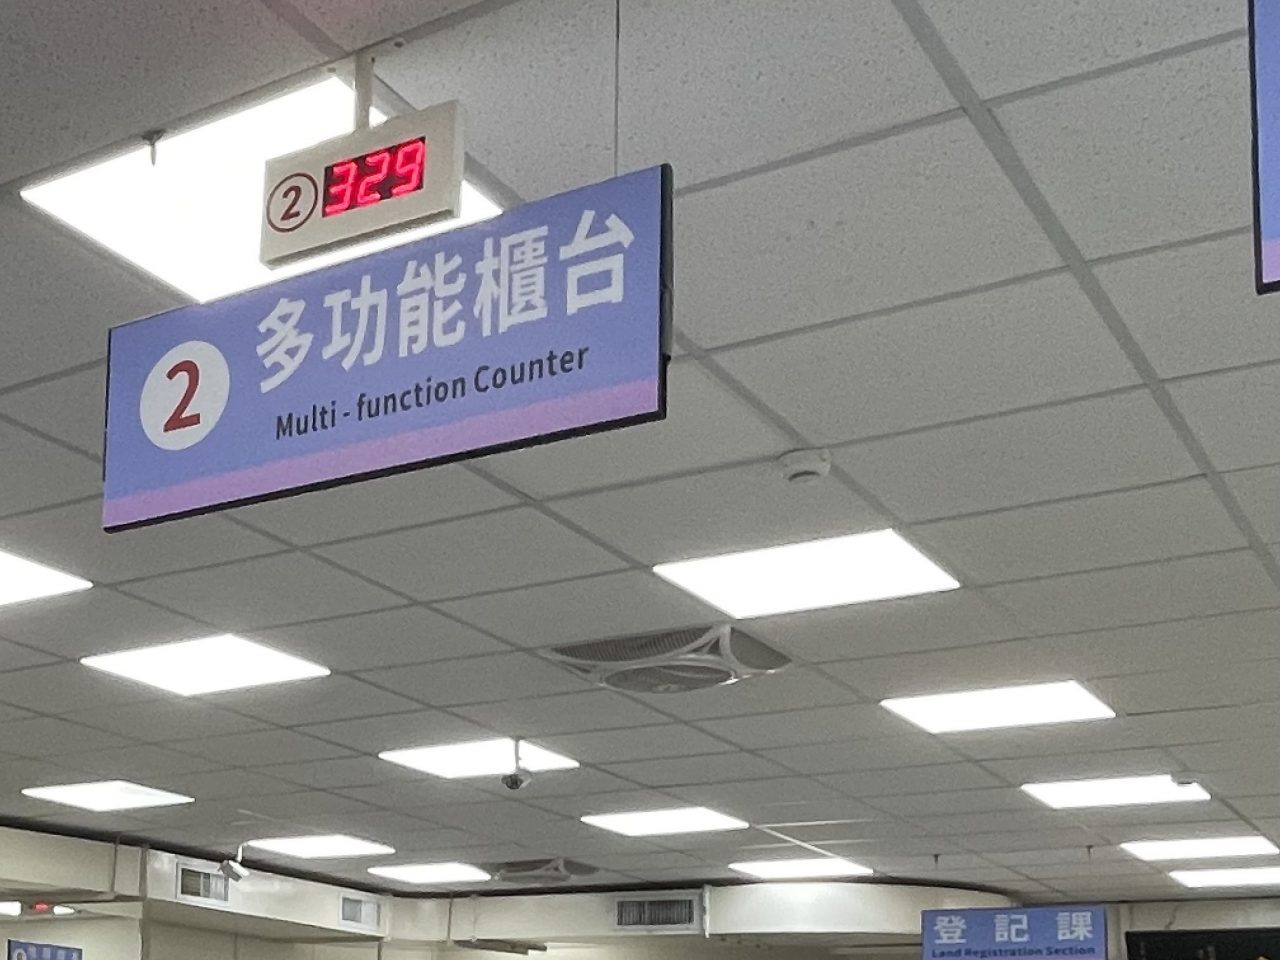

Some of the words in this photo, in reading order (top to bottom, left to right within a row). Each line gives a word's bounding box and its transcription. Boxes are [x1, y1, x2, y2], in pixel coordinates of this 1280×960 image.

[323, 139, 425, 215] 329
[281, 184, 301, 221] 2
[256, 209, 634, 393] 多功能櫃台
[474, 344, 589, 394] Counter
[162, 359, 201, 432] 2
[934, 911, 1094, 944] 登記課
[931, 949, 962, 959] Land
[964, 947, 1045, 960] Registration
[1046, 946, 1096, 957] Section
